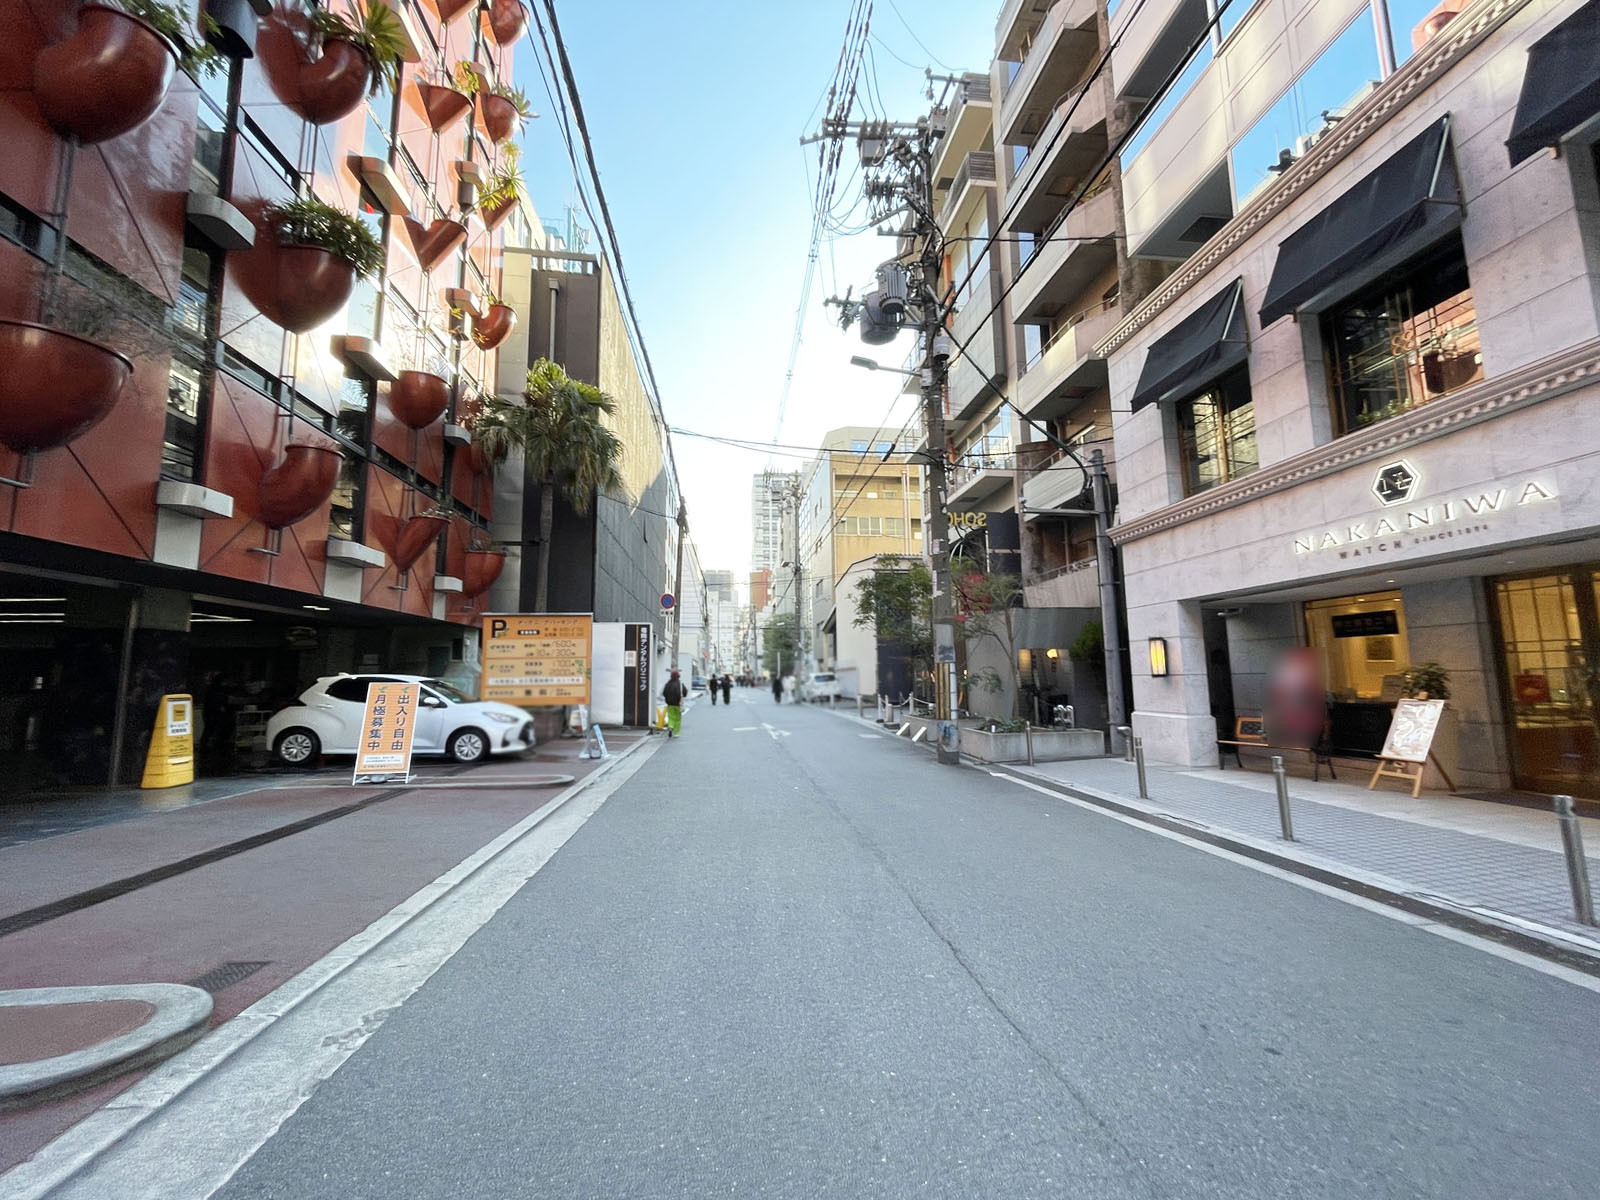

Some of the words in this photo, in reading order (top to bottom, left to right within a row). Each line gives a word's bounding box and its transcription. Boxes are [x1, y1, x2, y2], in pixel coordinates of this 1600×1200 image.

[1293, 479, 1560, 556] NAKANIWA
[1339, 536, 1404, 560] WATCH
[1413, 528, 1454, 546] SINCE
[491, 619, 508, 639] P
[367, 694, 387, 751] 月極募集中
[391, 694, 411, 751] 出入り自由
